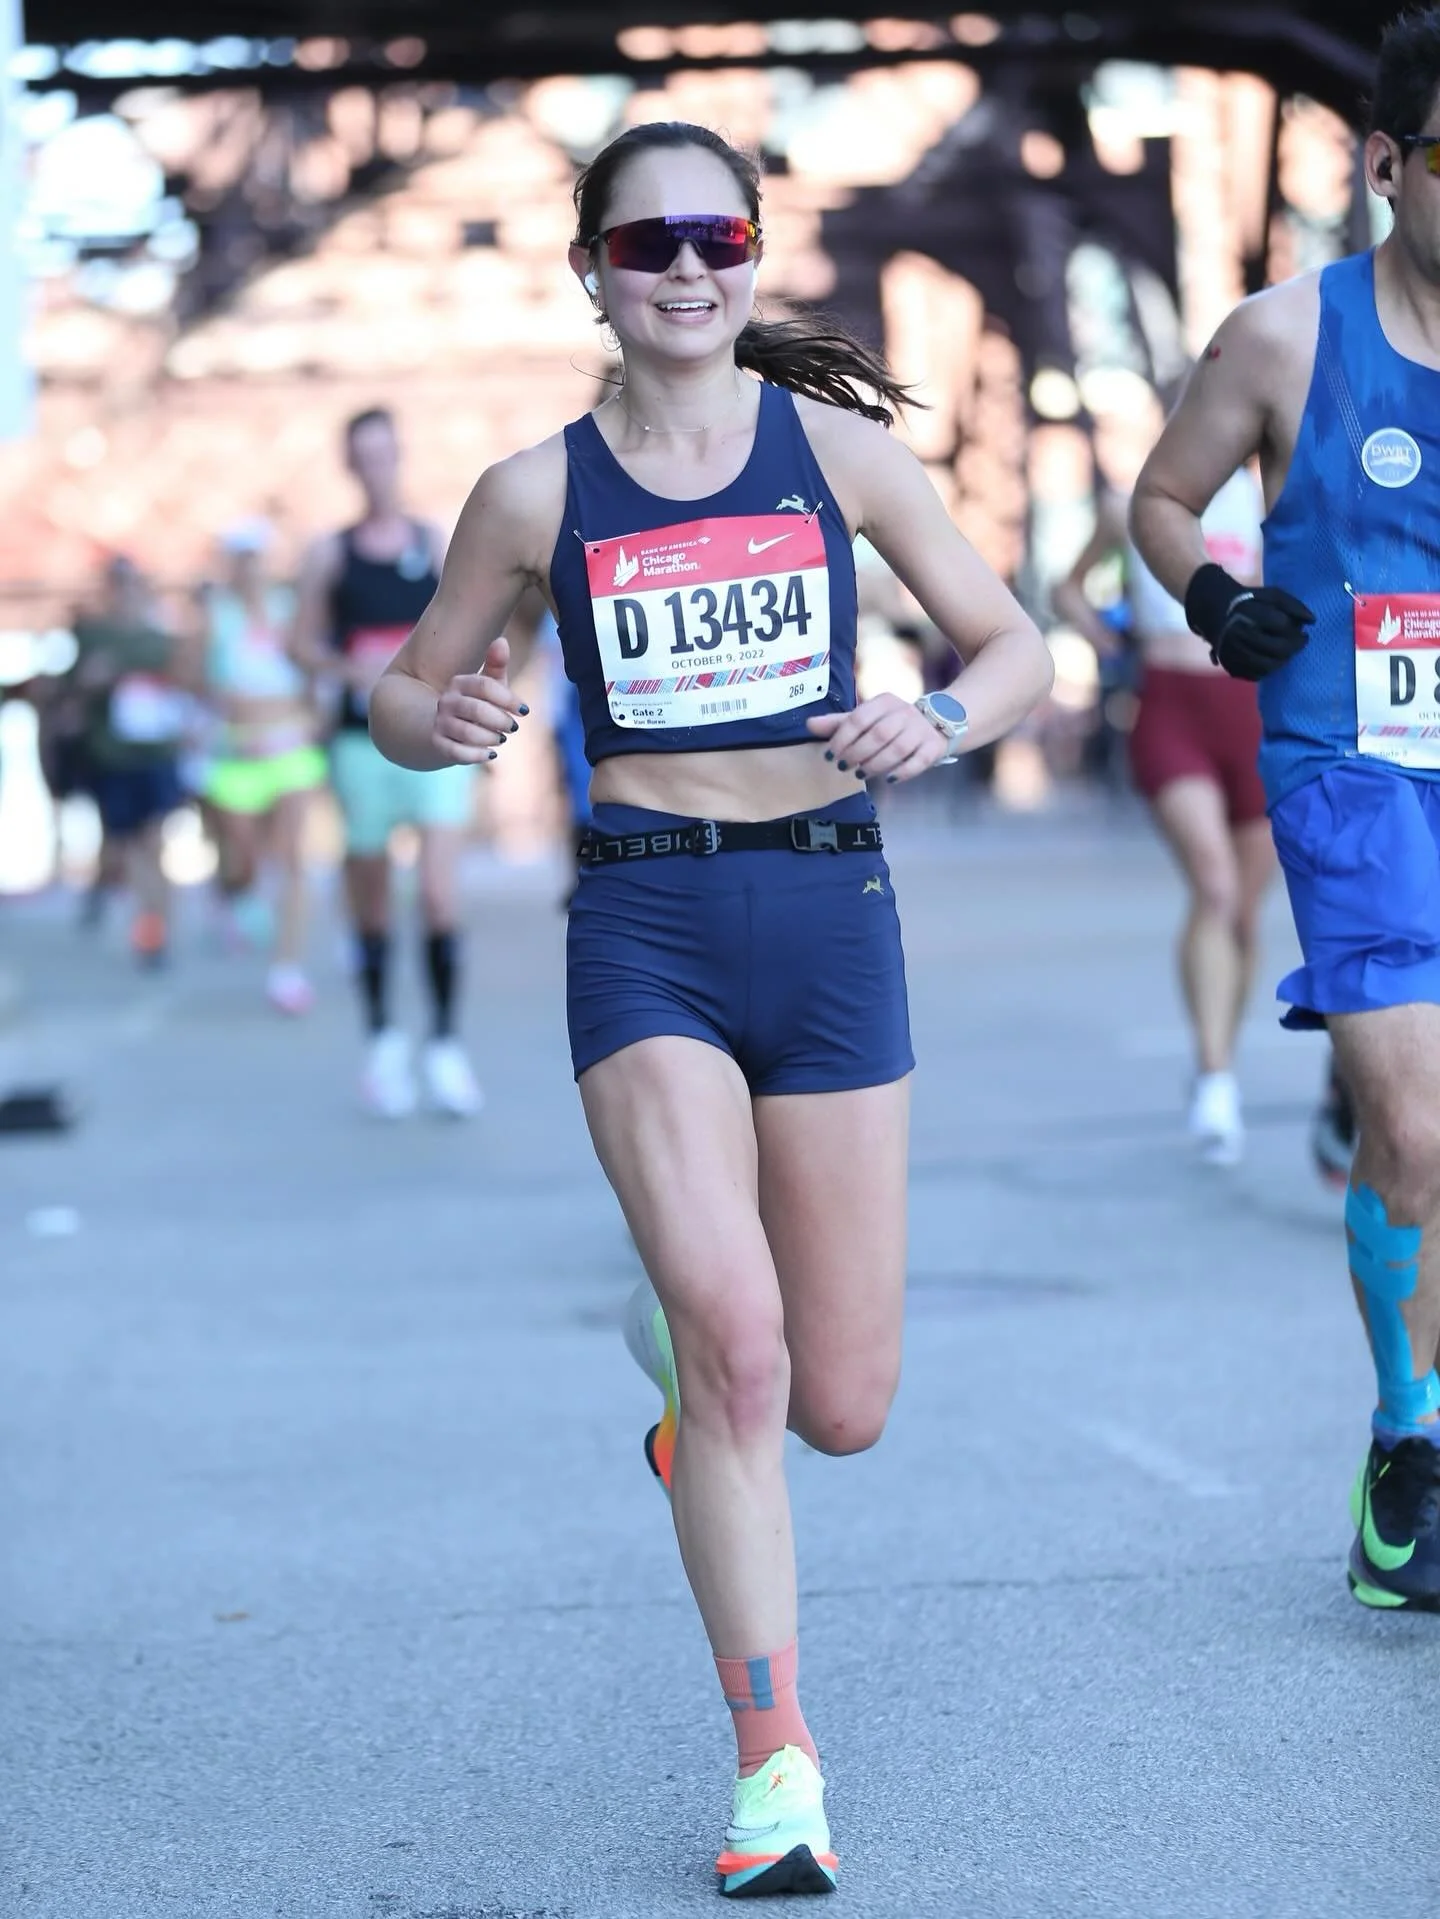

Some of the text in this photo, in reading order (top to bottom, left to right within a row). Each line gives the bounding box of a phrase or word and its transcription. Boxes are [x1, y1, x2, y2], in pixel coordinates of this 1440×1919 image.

[641, 547, 658, 555] BANK
[668, 541, 697, 551] AMERICA
[642, 552, 686, 567] Chicago
[613, 575, 812, 660] D 13434
[671, 649, 765, 670] OCTOBER 9, 2022
[1389, 655, 1416, 706] D
[789, 683, 805, 699] 269
[632, 708, 663, 717] Gate 2
